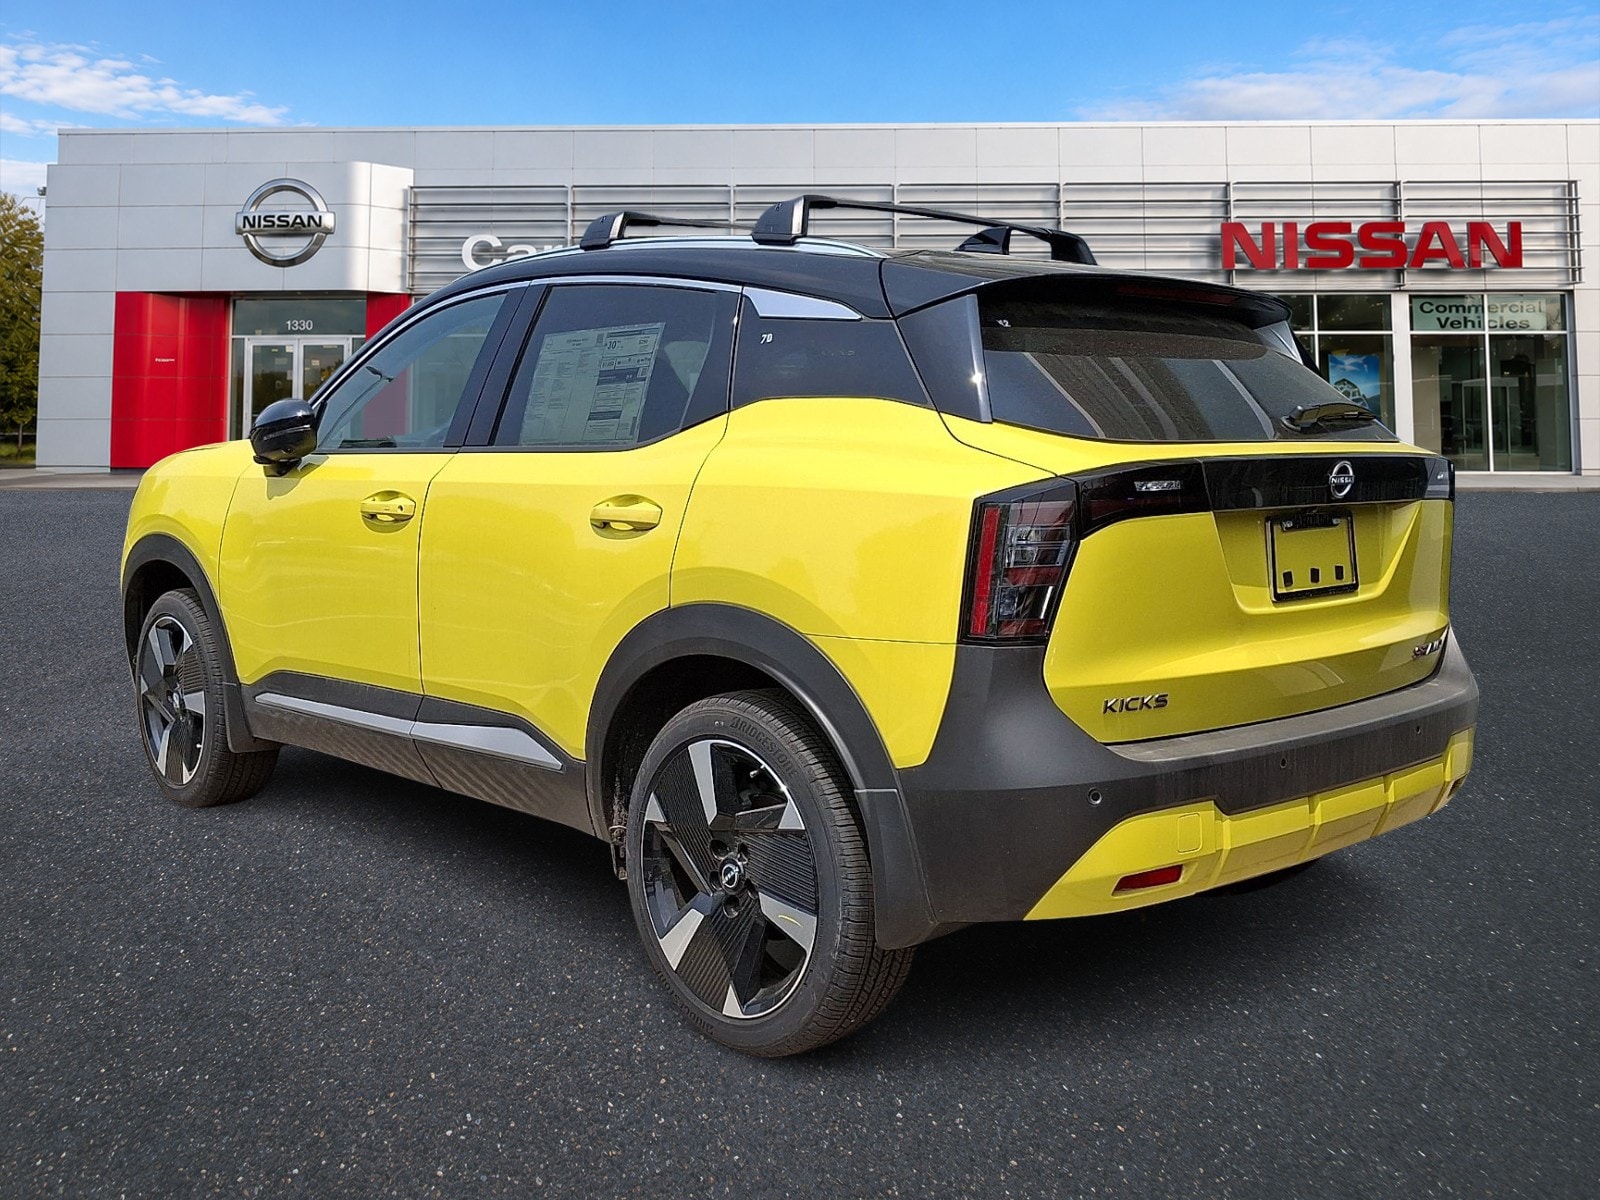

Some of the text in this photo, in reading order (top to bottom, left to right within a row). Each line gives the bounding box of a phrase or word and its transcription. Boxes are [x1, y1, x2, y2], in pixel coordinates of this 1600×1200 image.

[243, 215, 322, 229] NISSAN
[1221, 222, 1522, 270] NISSAN
[1420, 301, 1542, 314] Commercial
[286, 320, 314, 331] 1330
[1436, 315, 1530, 329] Vehicles
[1102, 693, 1168, 714] KICKS
[729, 716, 799, 777] BRIDGESTONE
